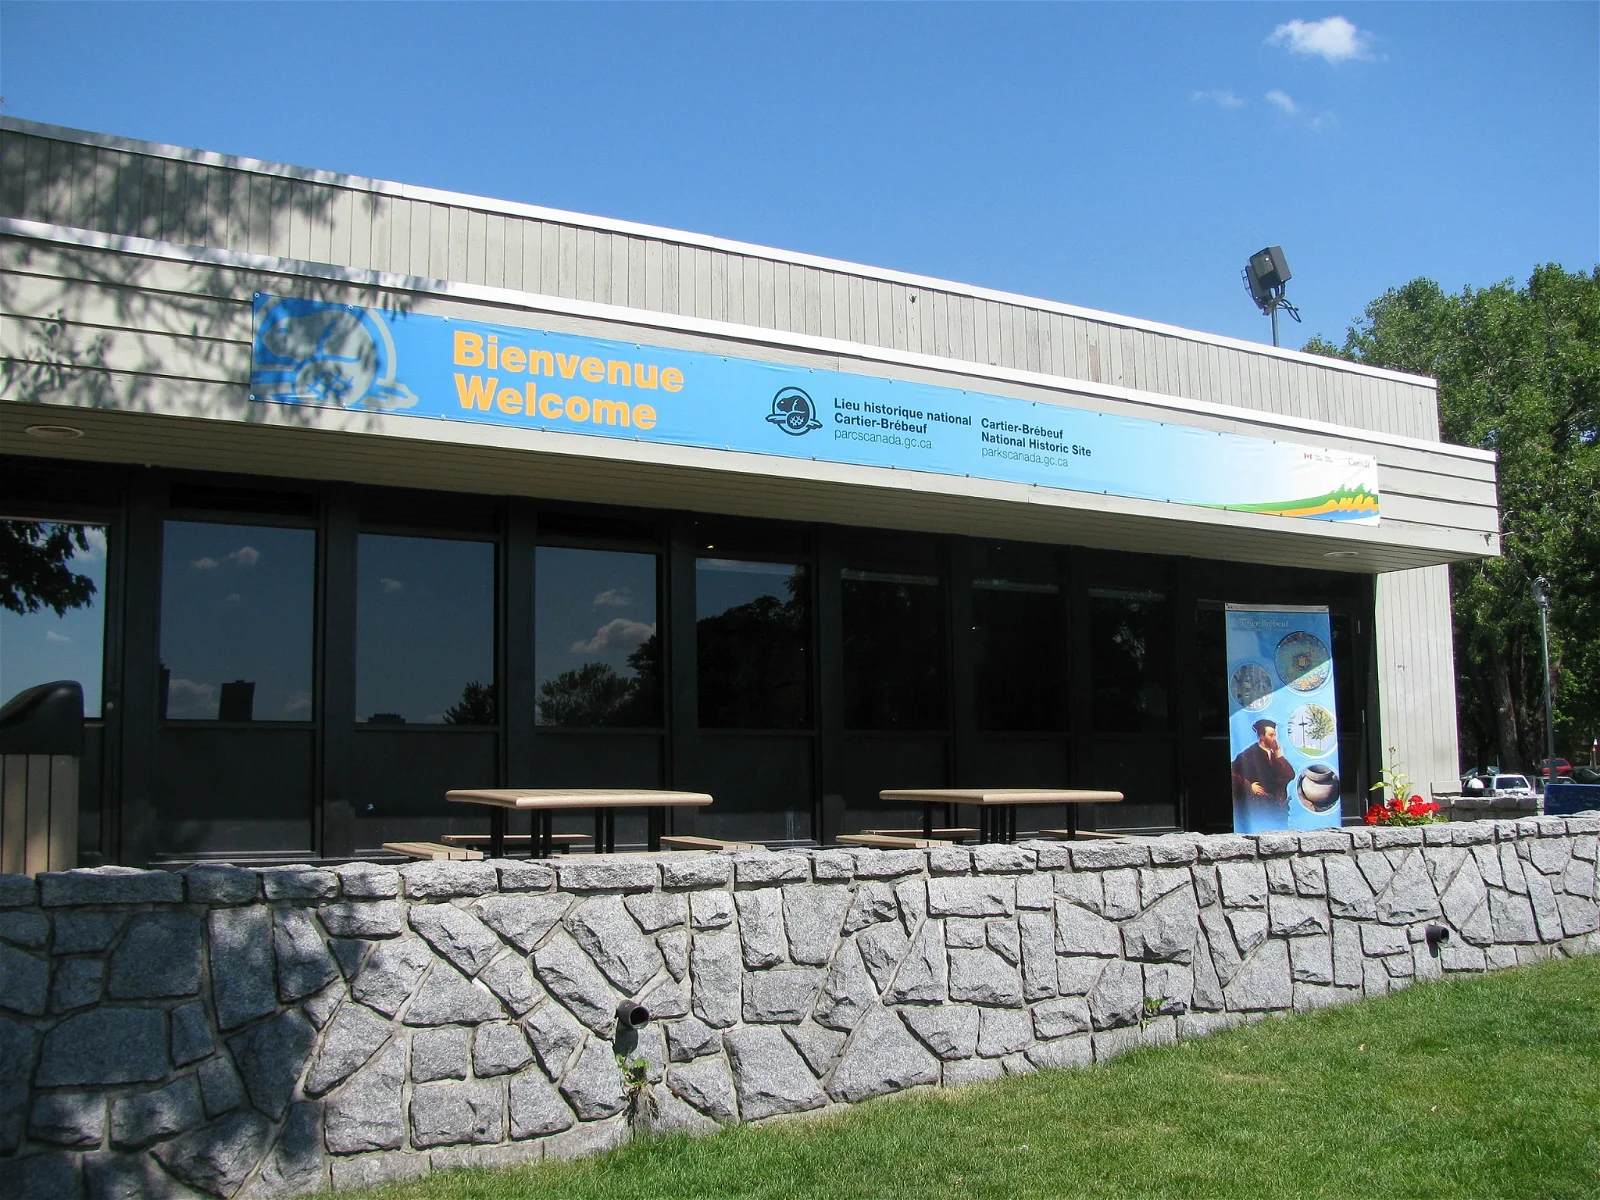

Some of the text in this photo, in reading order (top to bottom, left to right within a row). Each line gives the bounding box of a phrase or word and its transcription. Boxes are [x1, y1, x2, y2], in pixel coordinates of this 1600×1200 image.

[453, 330, 684, 392] Bienvenue
[453, 372, 657, 430] Welcome
[834, 397, 972, 426] Lieu historique national
[834, 412, 927, 434] Cartier-Brébeuf
[981, 417, 1063, 439] Cartier-Brébeuf
[834, 429, 932, 449] parcscanada.gc.ca
[981, 431, 1092, 457] National Historic Site
[981, 447, 1068, 467] parkscanada.gc.ca
